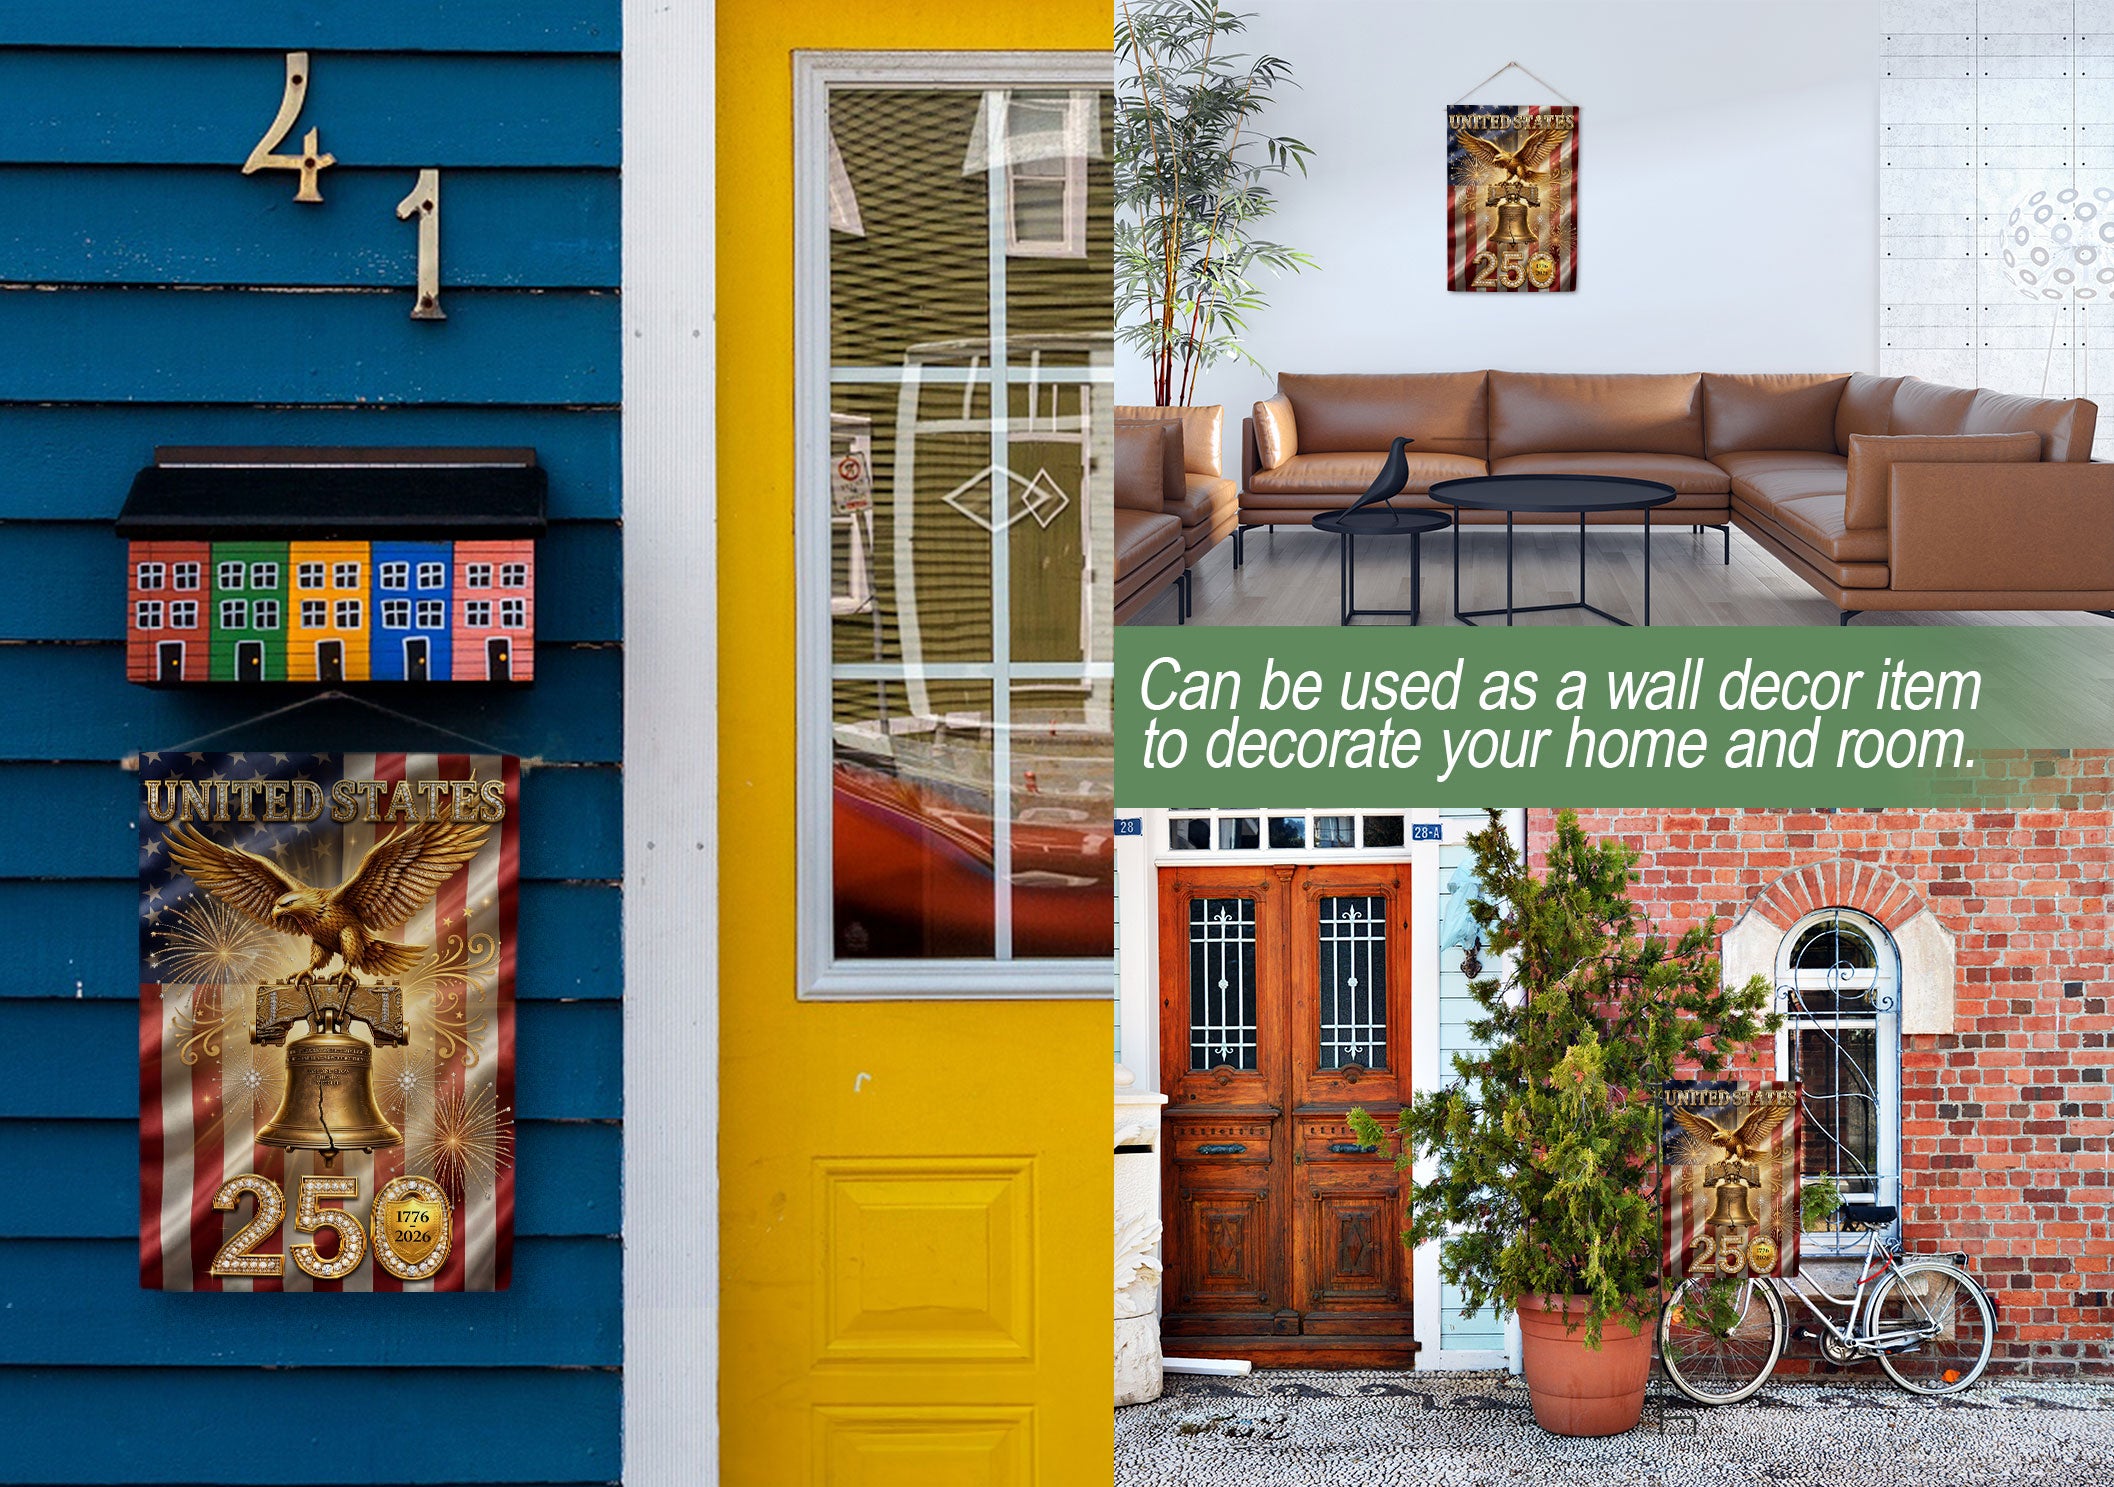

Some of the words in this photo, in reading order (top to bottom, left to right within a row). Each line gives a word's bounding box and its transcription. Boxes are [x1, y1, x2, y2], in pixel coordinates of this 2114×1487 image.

[1449, 115, 1512, 131] UNITED
[1513, 115, 1575, 131] STATES
[1472, 251, 1556, 288] 250
[145, 780, 323, 822] UNITED
[332, 780, 506, 822] STATES
[1120, 820, 1134, 833] 28
[1414, 826, 1440, 840] 28-A
[1665, 1090, 1730, 1106] UNITED
[1732, 1090, 1797, 1106] STATES
[396, 1210, 430, 1223] 1776
[211, 1174, 453, 1280] 250
[394, 1230, 432, 1243] 2026
[1688, 1234, 1778, 1274] 250
